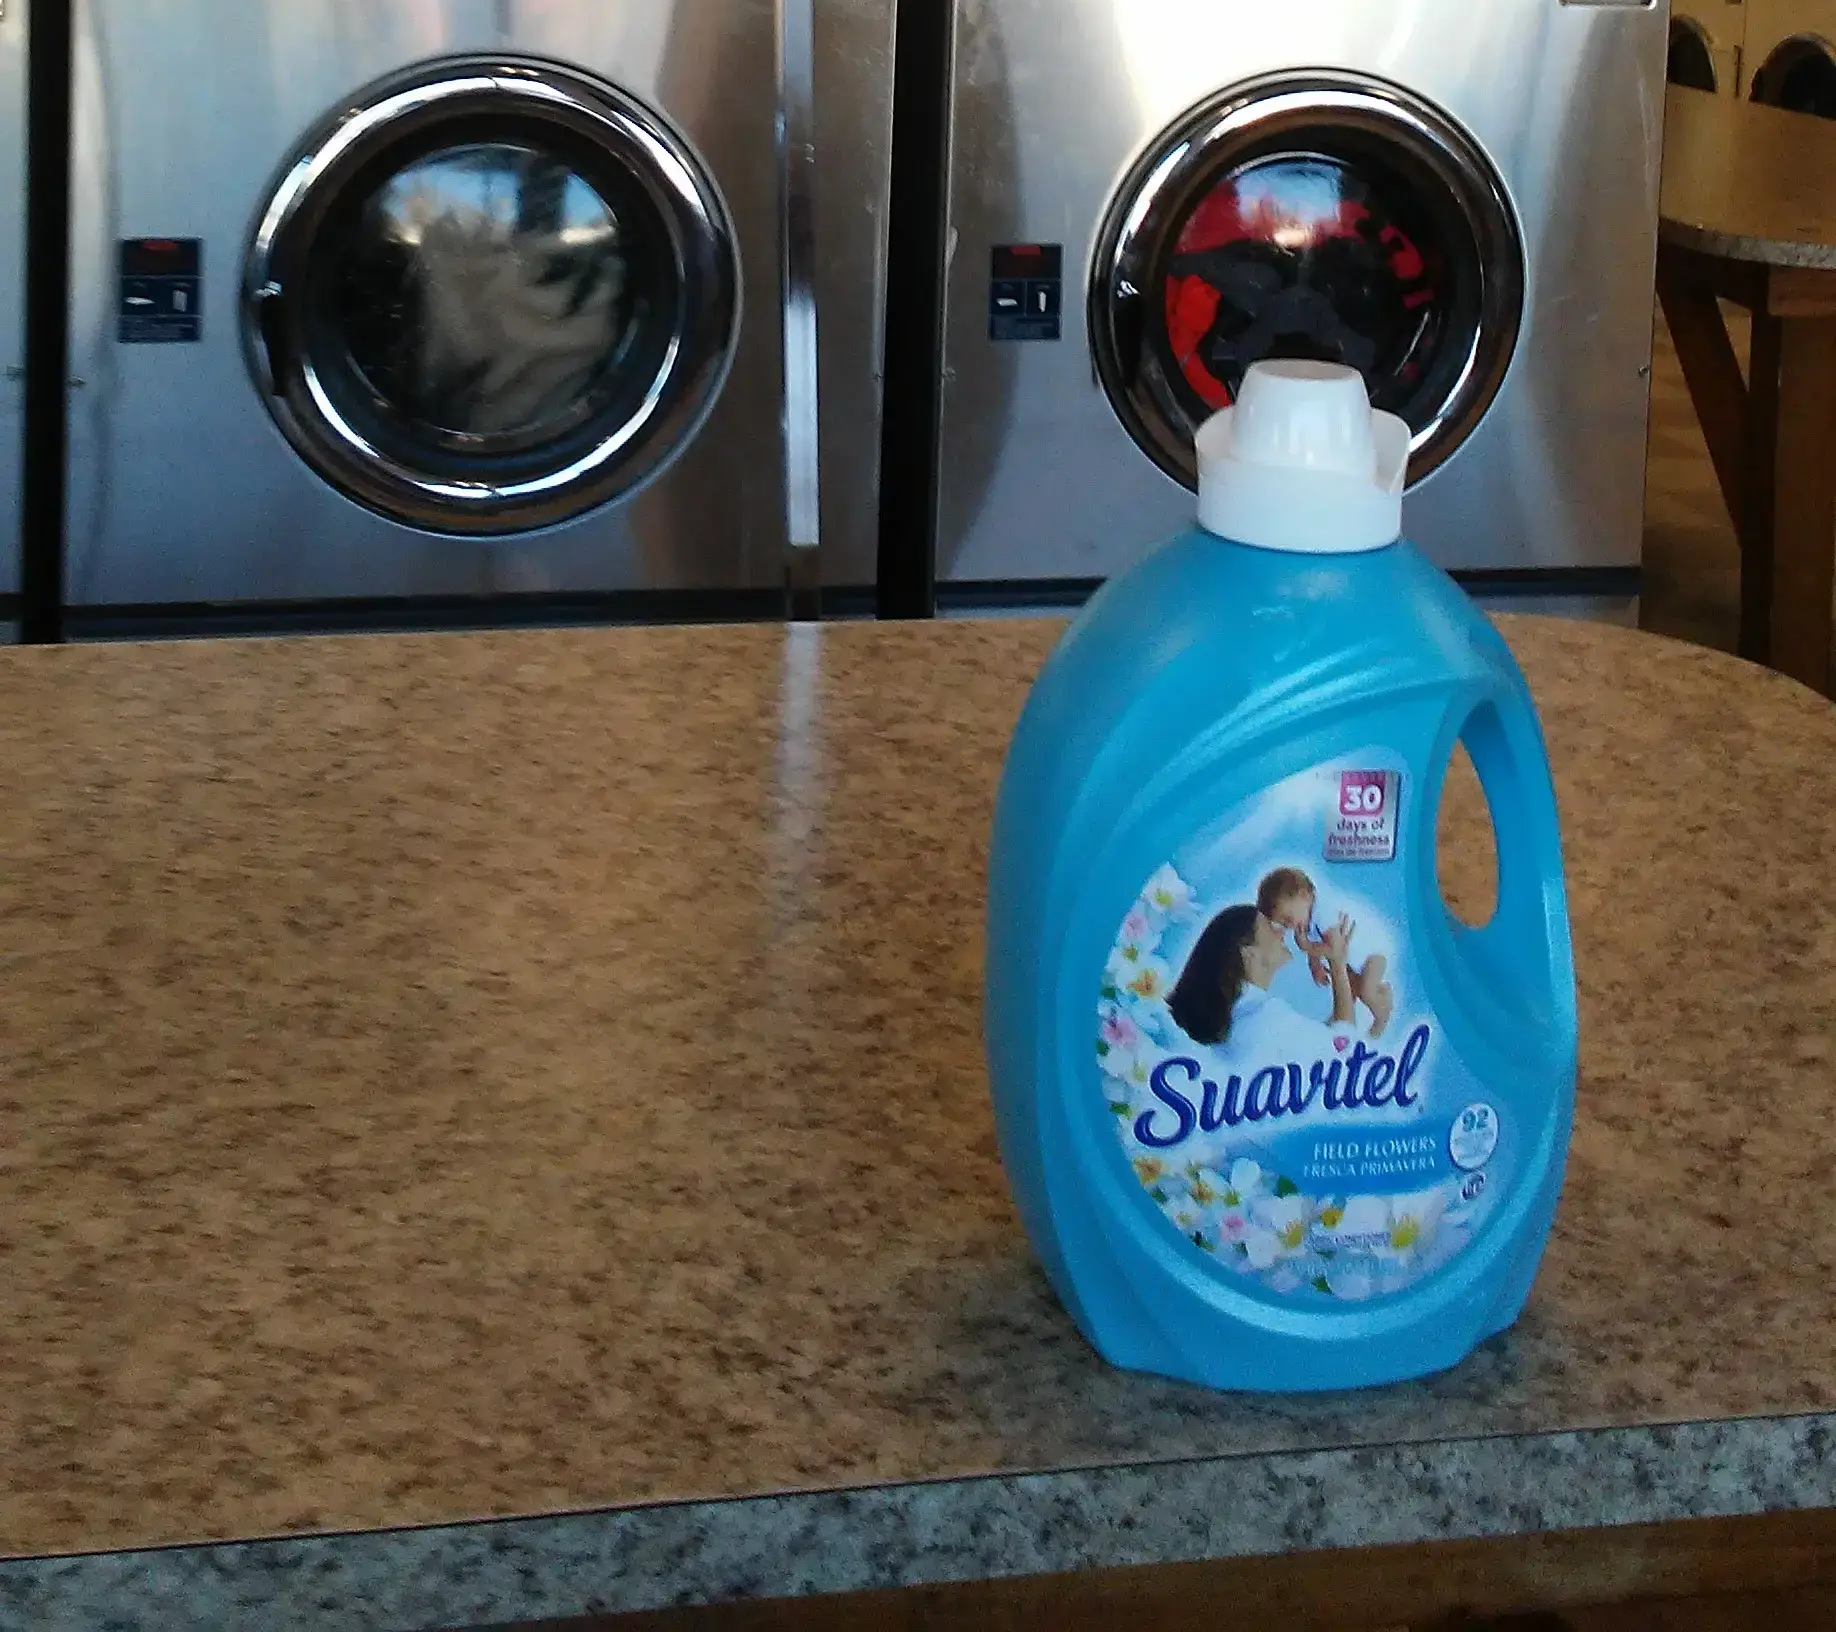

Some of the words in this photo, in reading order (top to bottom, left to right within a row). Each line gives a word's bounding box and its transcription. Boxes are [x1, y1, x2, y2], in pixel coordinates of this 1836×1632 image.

[1344, 784, 1382, 811] 30
[1328, 832, 1390, 846] freshness
[1336, 817, 1367, 837] days
[1371, 817, 1385, 831] of
[1133, 1023, 1430, 1148] Suavitel
[1462, 1108, 1489, 1132] 92
[1314, 1140, 1360, 1160] FIELD
[1365, 1135, 1437, 1157] FLOWERS
